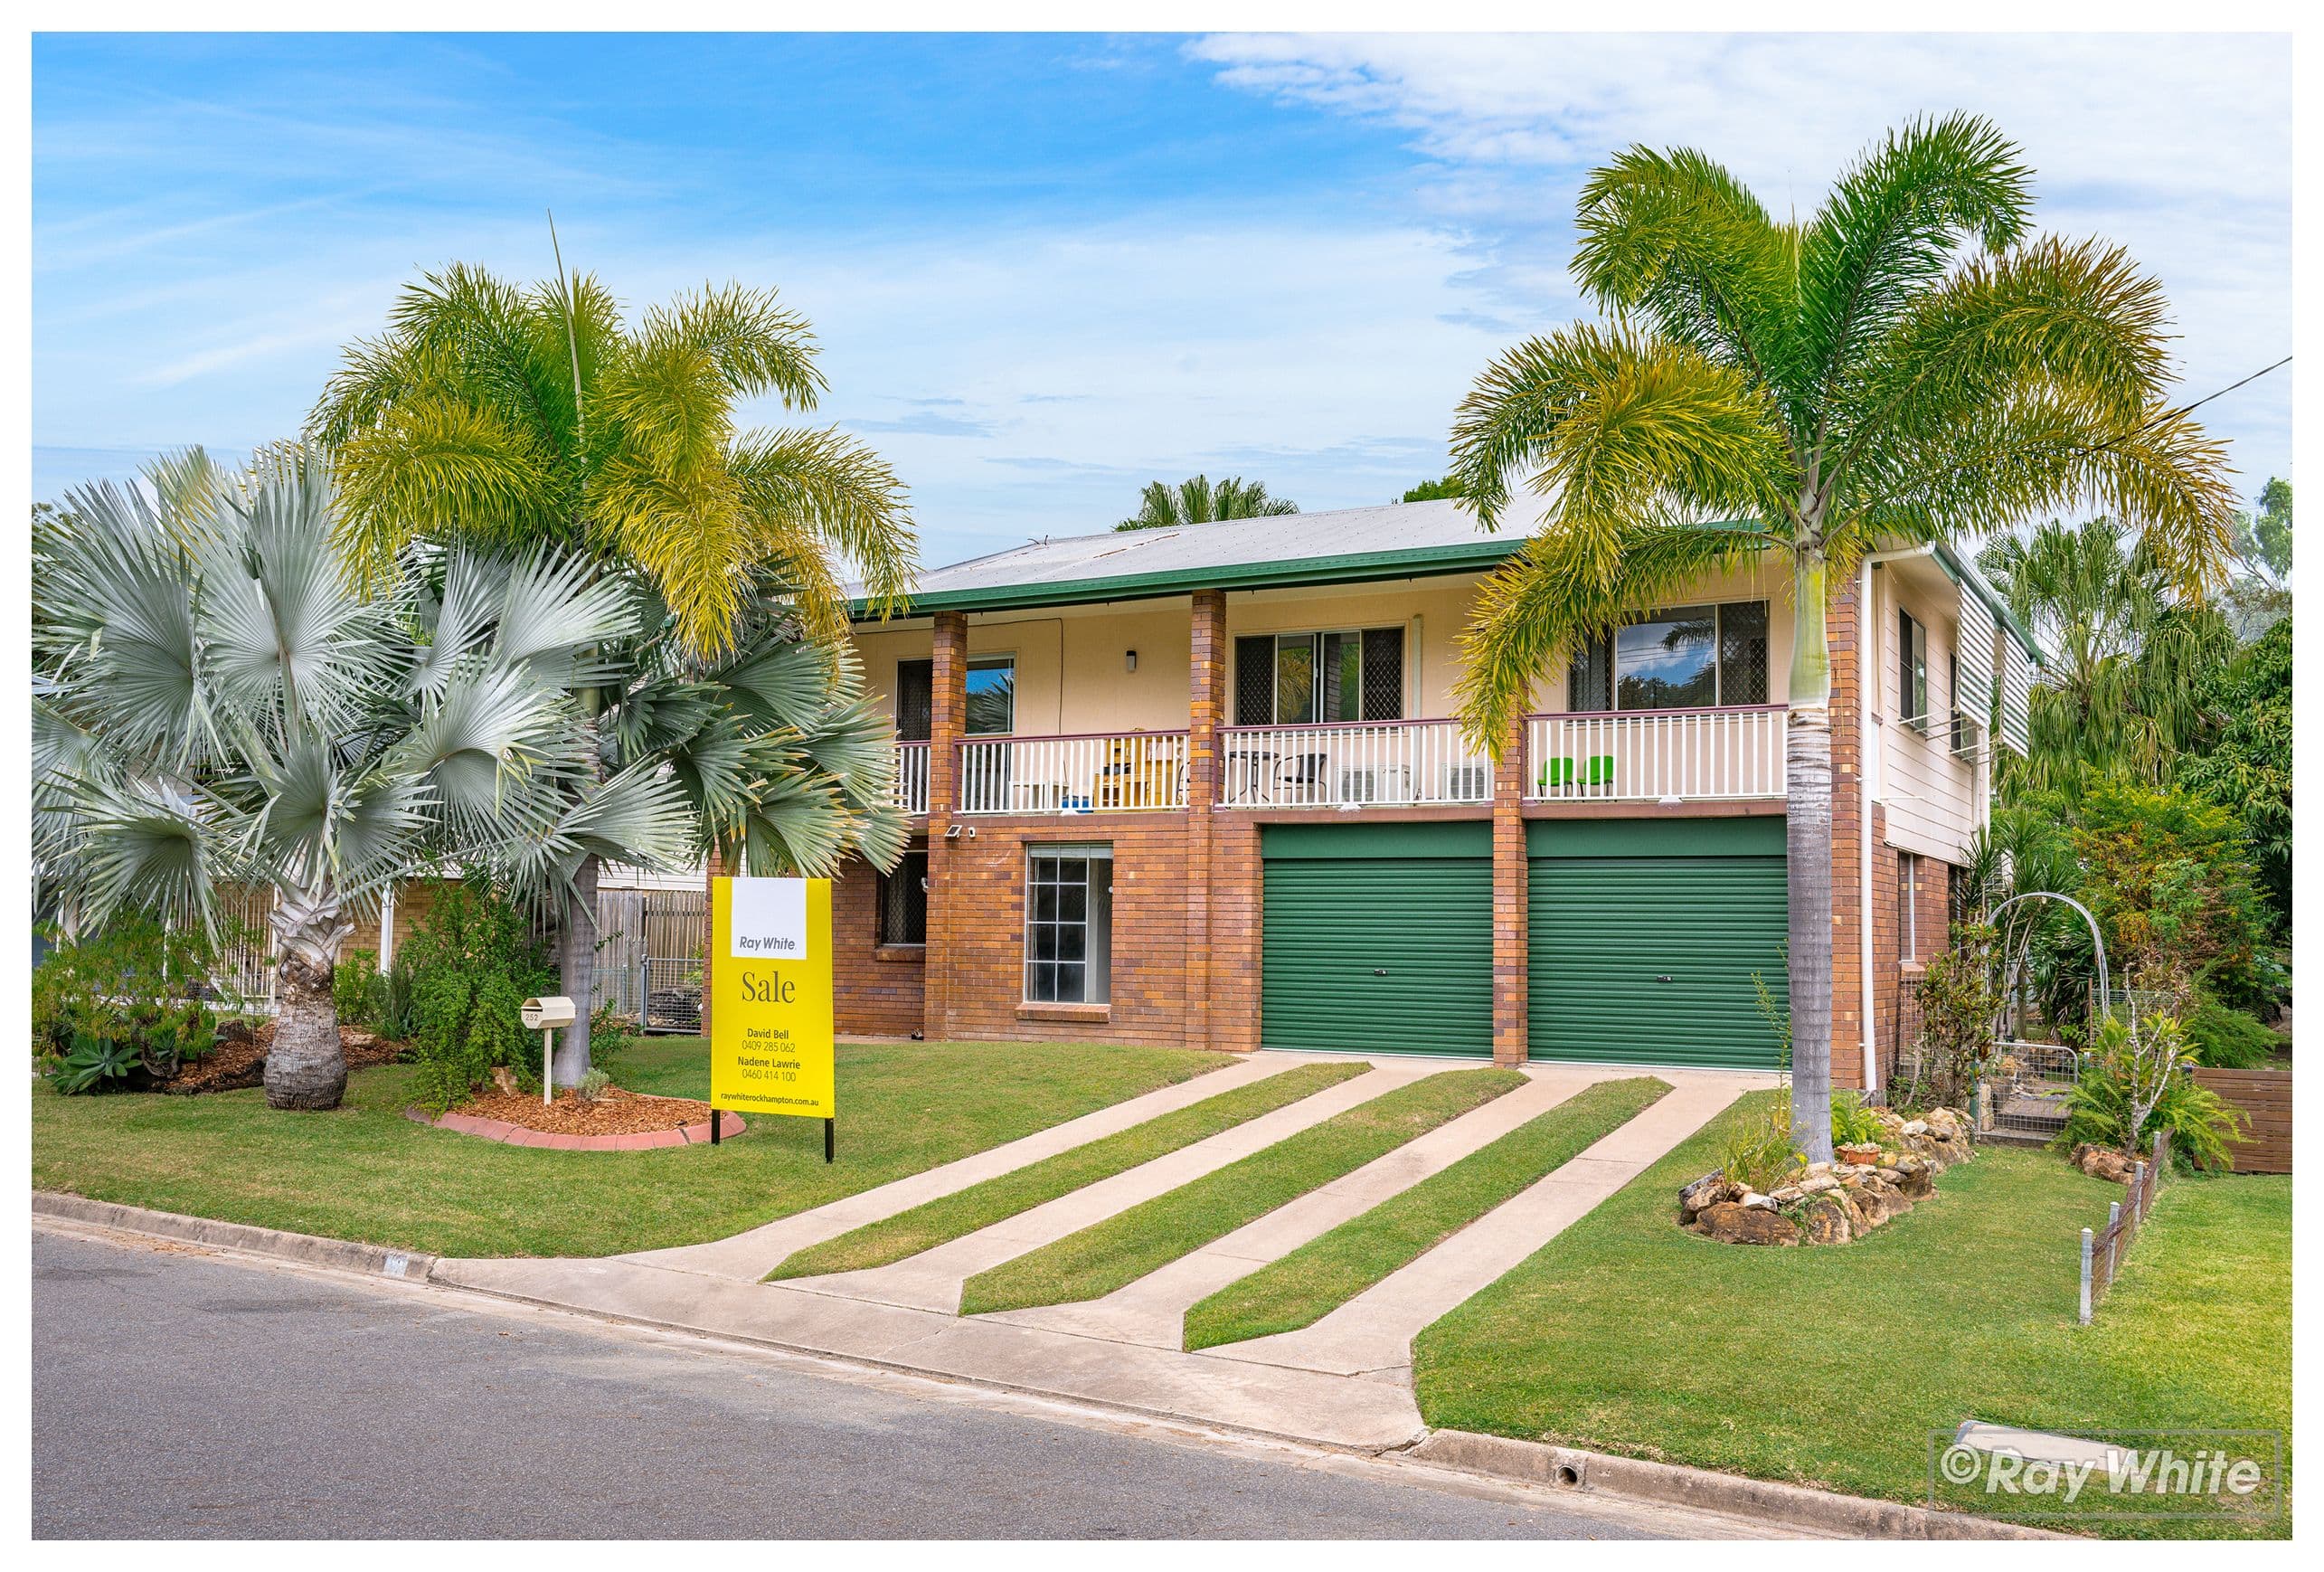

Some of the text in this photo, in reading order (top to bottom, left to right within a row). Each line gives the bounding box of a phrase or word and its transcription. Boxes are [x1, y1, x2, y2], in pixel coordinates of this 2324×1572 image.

[740, 936, 796, 951] Ray White
[742, 971, 796, 1003] Sale
[747, 1028, 789, 1039] David Bell
[742, 1040, 796, 1053] 0409 285 062
[737, 1056, 801, 1069] Nadene Lawrie
[742, 1069, 796, 1082] 0460 414 100
[721, 1093, 819, 1106] raywhiterockhampton.com.au
